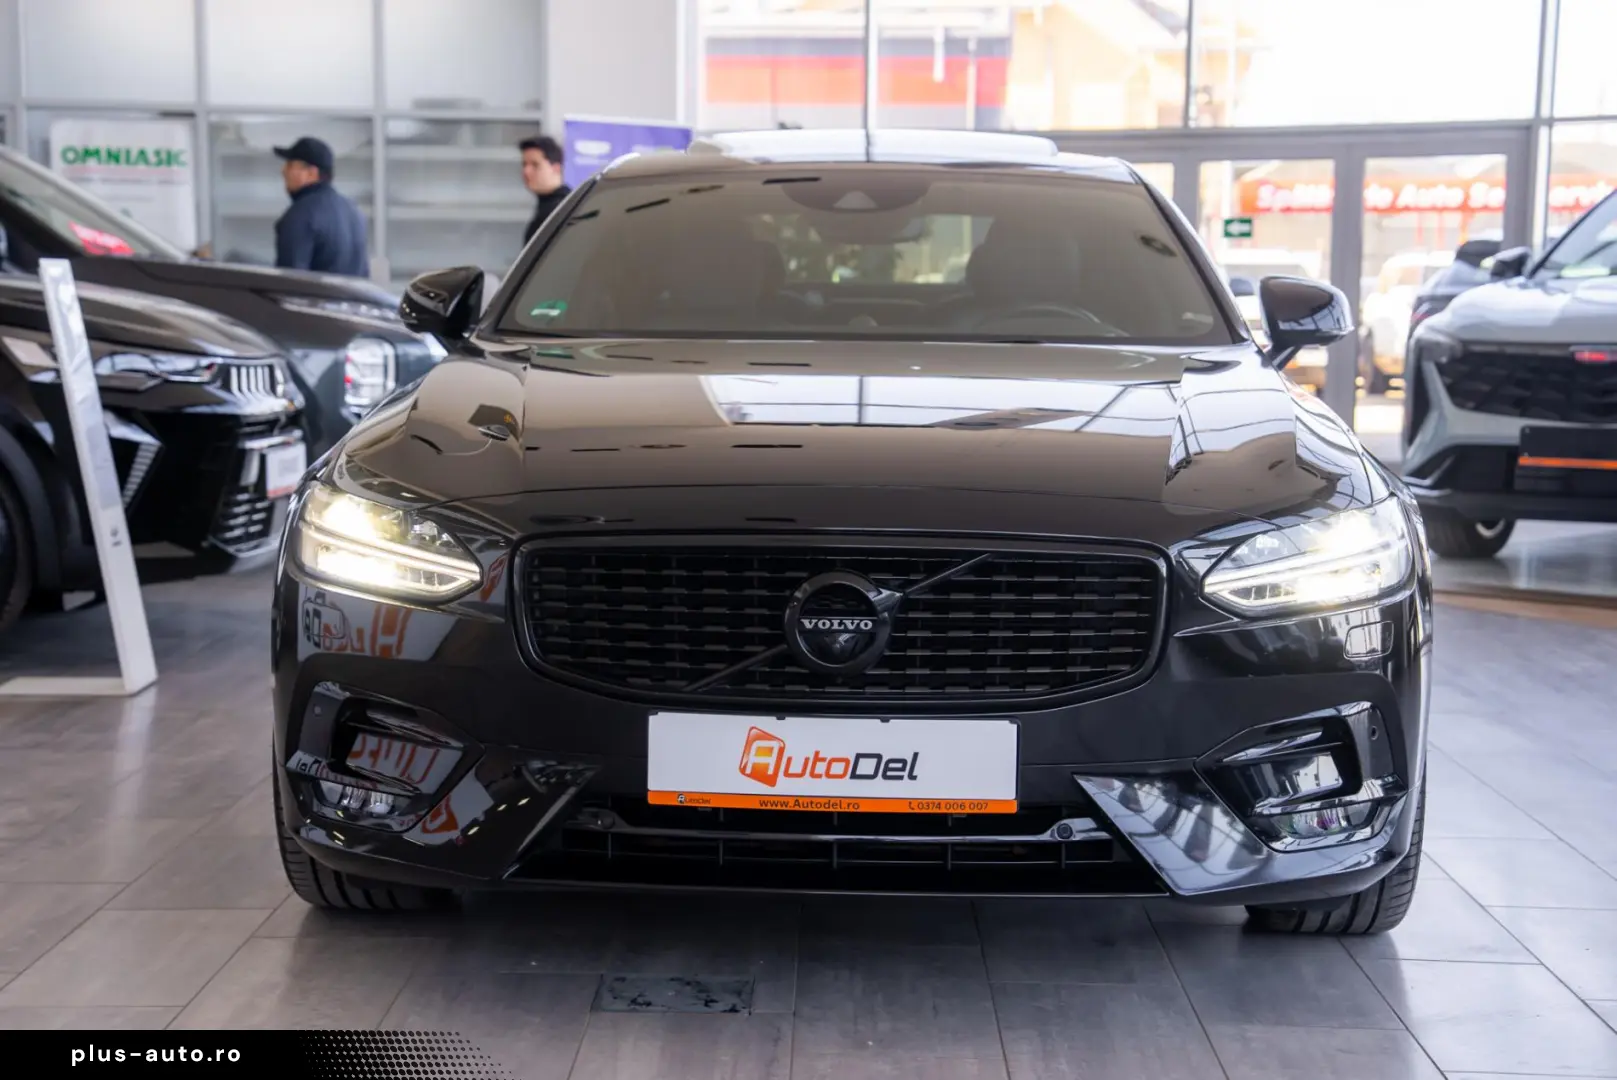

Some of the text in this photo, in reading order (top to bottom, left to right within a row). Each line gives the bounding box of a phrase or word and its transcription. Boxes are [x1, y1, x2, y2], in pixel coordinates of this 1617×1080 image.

[800, 619, 873, 630] VOLVO
[739, 726, 919, 787] AutoDel
[759, 799, 860, 811] www.Autodel.ro
[917, 801, 989, 811] 0374 006 007
